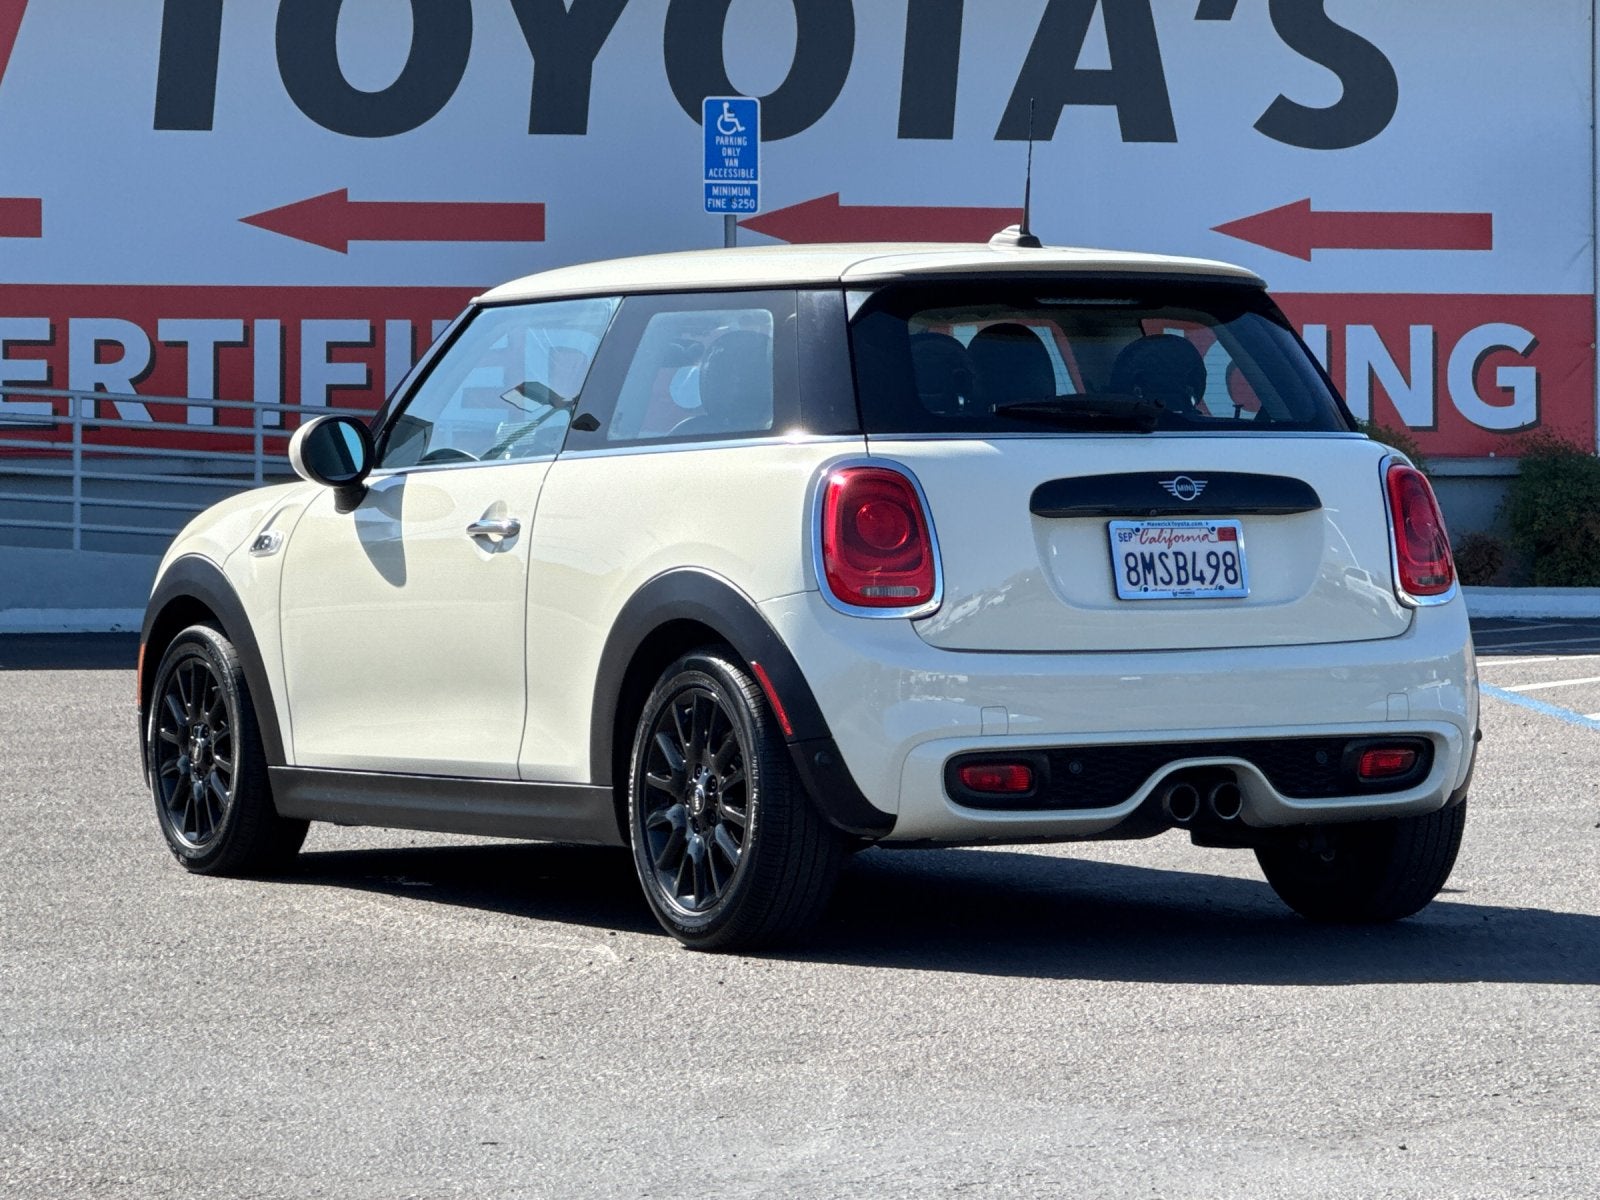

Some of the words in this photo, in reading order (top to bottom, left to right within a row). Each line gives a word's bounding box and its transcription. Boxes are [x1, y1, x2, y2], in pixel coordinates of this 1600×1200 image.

[153, 0, 1399, 150] TOYOTAS
[715, 135, 748, 146] PARKING
[721, 147, 741, 157] ONLY
[724, 157, 739, 167] VAN
[708, 168, 754, 179] ACCESSIBLE
[711, 186, 751, 196] MINIMUM
[707, 198, 727, 208] FINE
[731, 198, 755, 209] $250
[1176, 484, 1195, 492] MINI
[1117, 531, 1133, 543] SEP
[1139, 527, 1210, 550] California
[1124, 550, 1239, 587] 8MSB498
